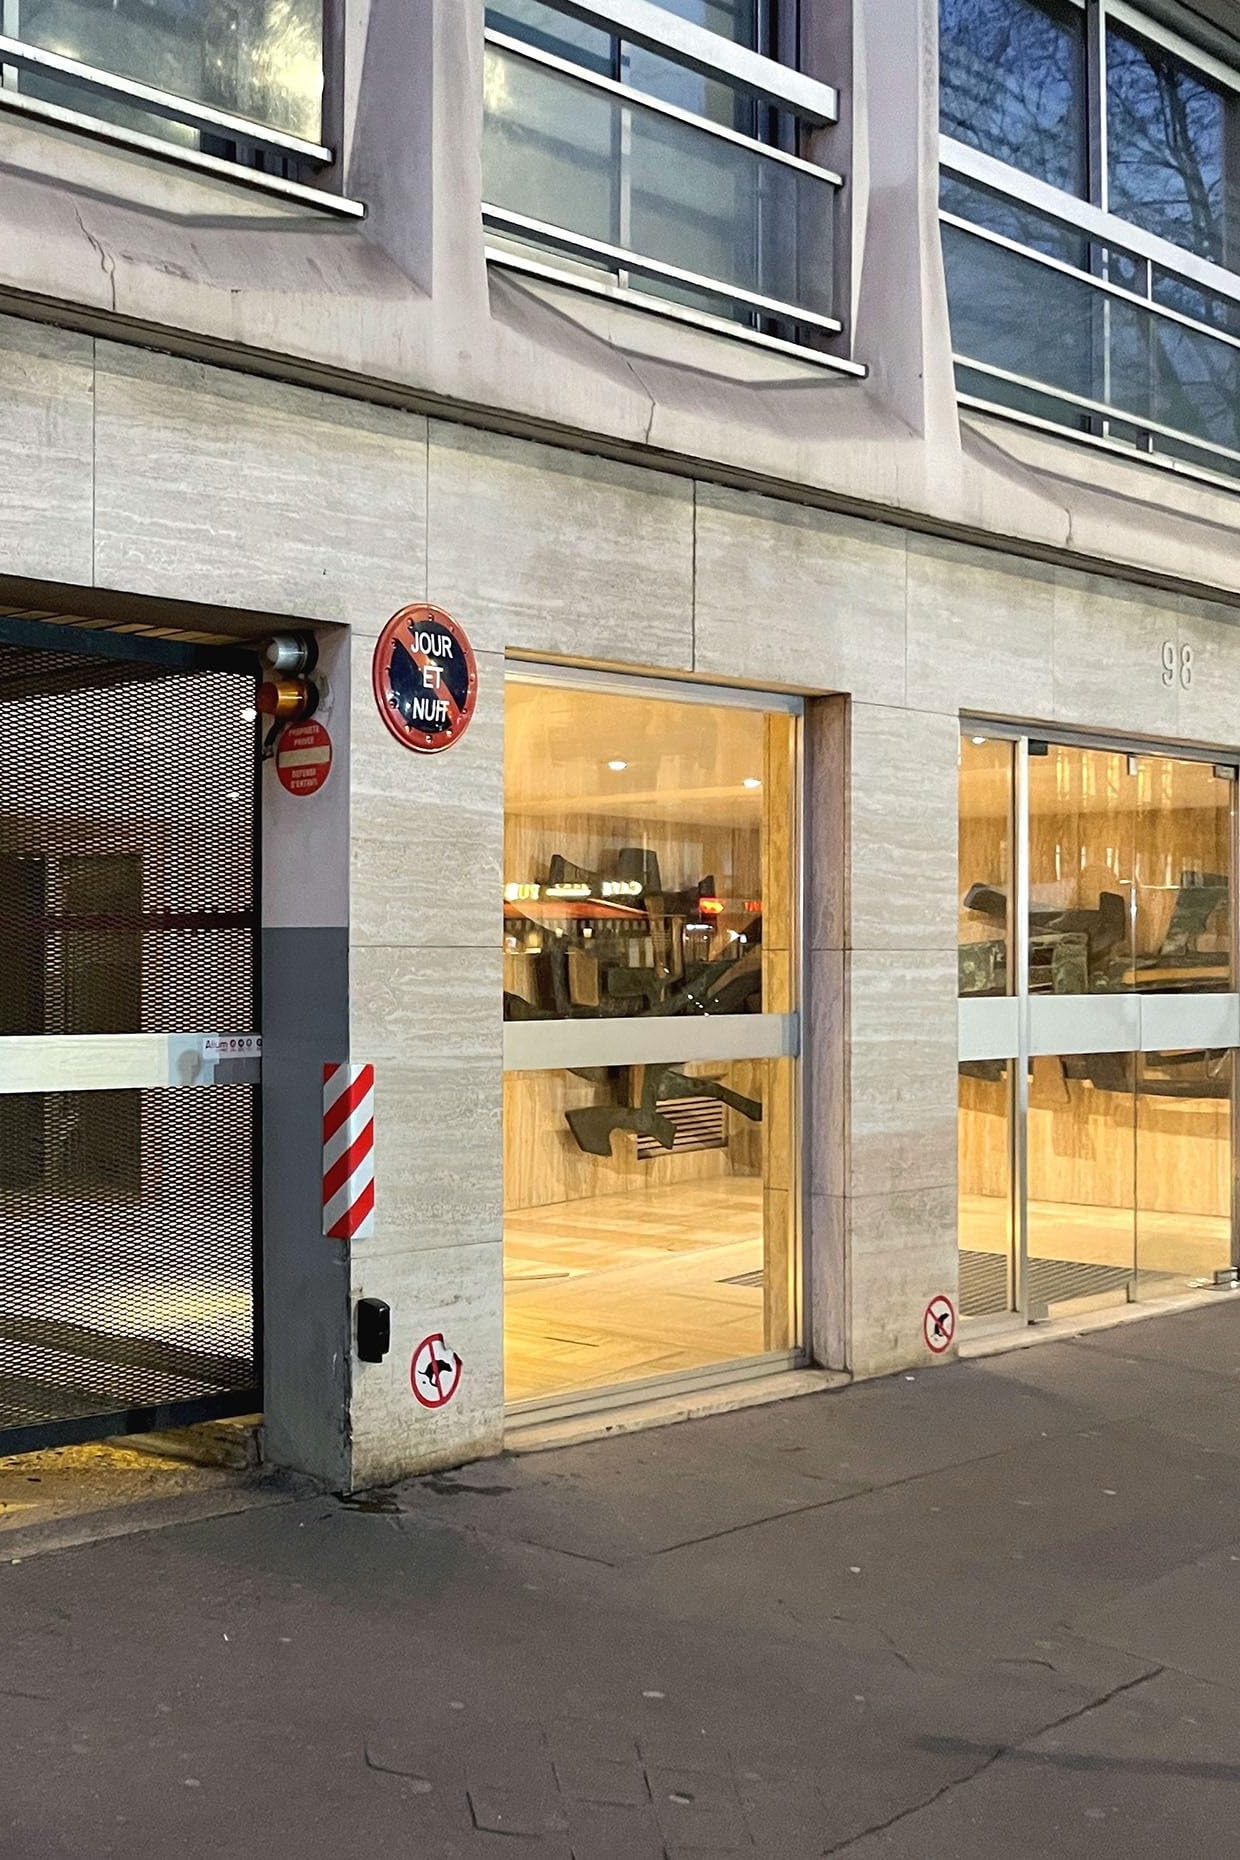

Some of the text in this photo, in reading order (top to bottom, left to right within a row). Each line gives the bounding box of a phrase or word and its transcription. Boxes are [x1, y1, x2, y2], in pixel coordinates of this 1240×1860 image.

[410, 631, 454, 659] JOUR
[422, 665, 444, 690] ET
[1161, 640, 1192, 691] 98
[412, 696, 450, 723] NUIT
